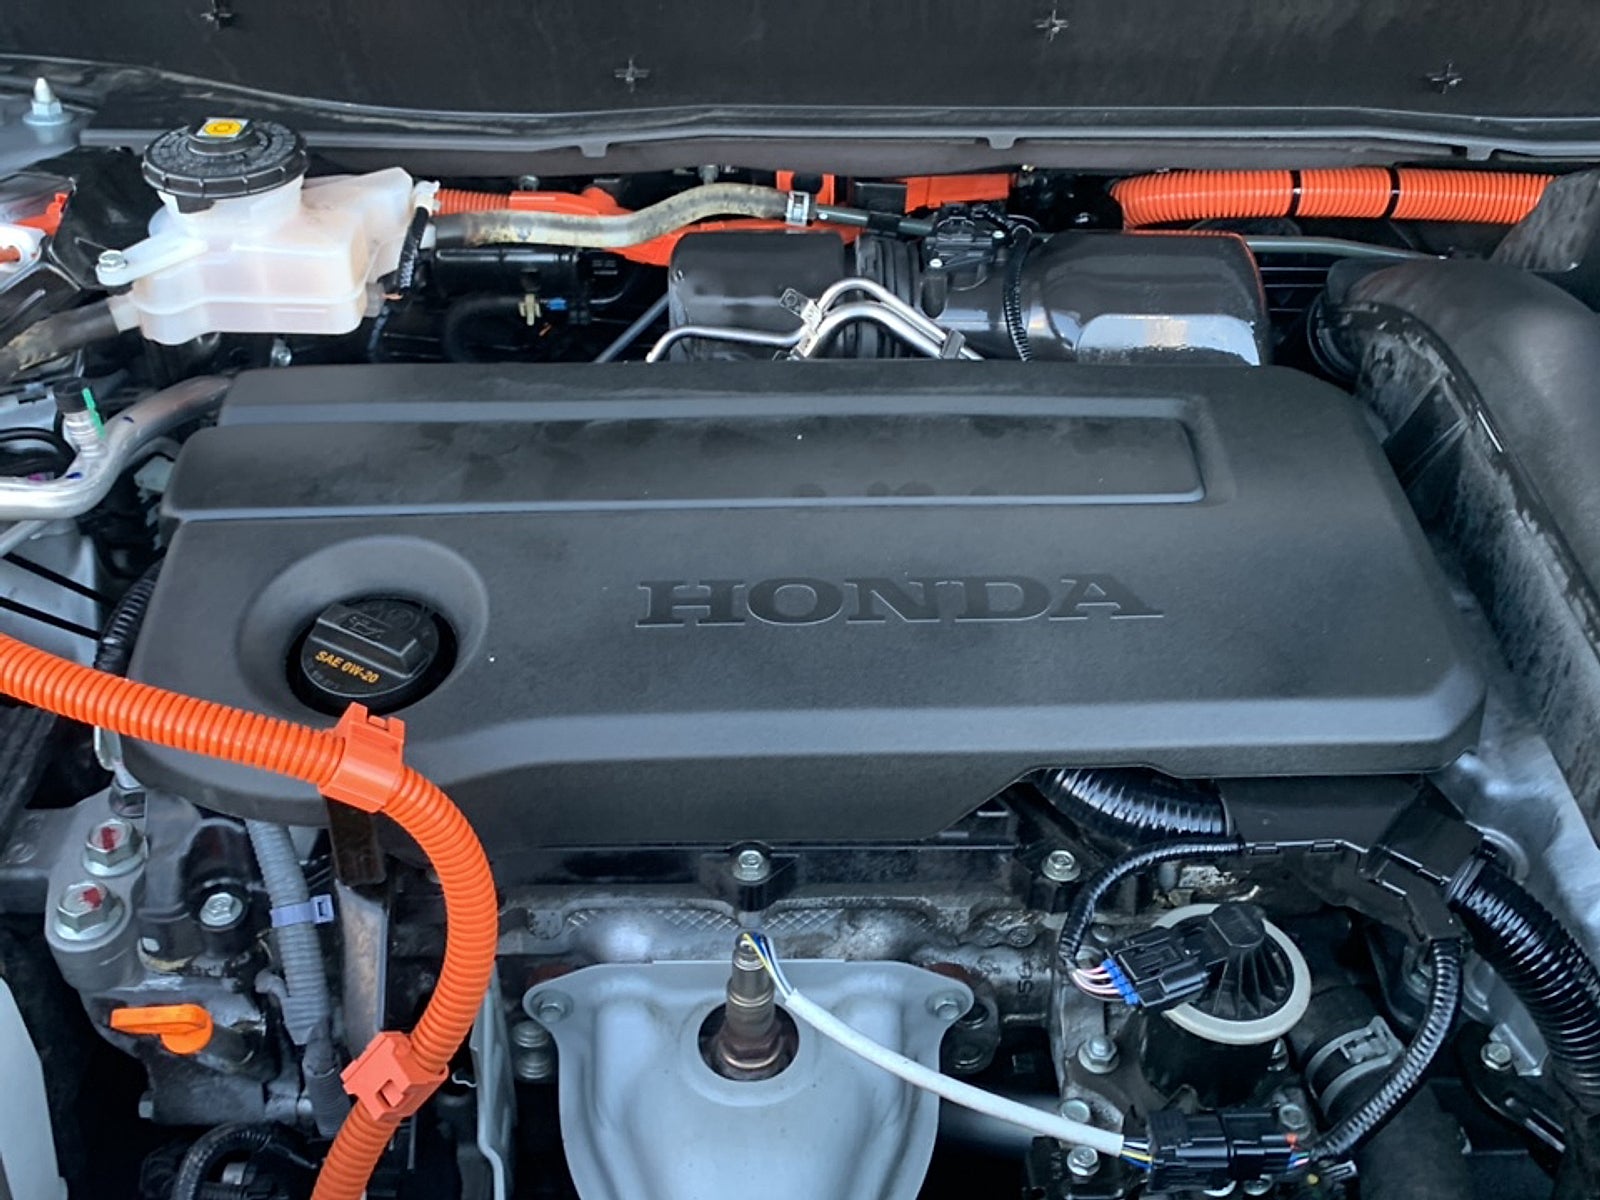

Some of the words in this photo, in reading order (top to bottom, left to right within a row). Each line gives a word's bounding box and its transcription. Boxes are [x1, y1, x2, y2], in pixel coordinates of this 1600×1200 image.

[635, 575, 1164, 627] HONDA
[316, 651, 343, 668] SAE
[342, 662, 379, 683] 0W-20
